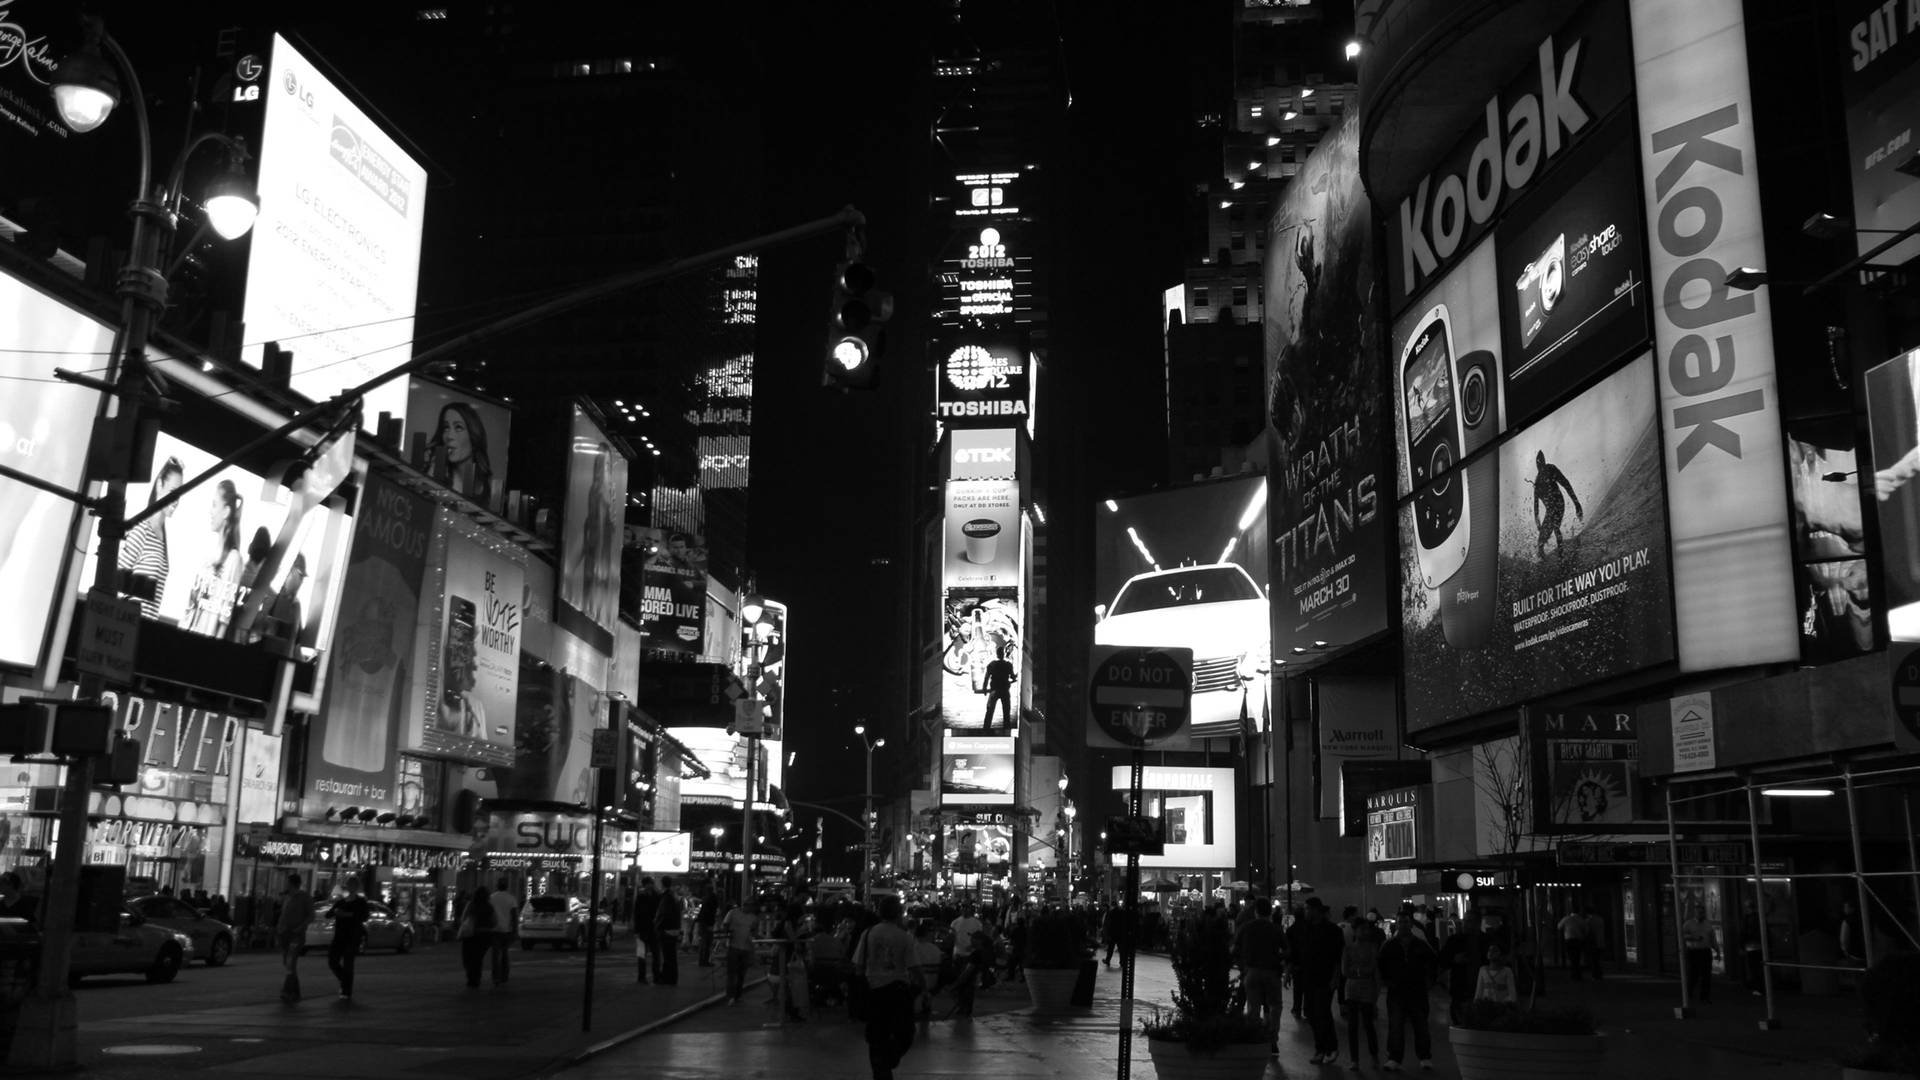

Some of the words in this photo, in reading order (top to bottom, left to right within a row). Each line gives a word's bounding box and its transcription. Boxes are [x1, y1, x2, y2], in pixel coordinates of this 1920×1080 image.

[1850, 0, 1897, 72] SAT
[234, 86, 260, 102] LG
[299, 84, 315, 109] LG
[1400, 34, 1590, 297] Kodak
[296, 181, 311, 206] LG
[313, 196, 388, 266] ELECTRONICS
[968, 244, 1005, 259] 2012
[1571, 223, 1615, 269] easyshare
[1601, 231, 1623, 257] touch
[959, 257, 1015, 269] TOSHIBA
[959, 279, 1014, 291] TOSHIBA
[1651, 102, 1766, 474] Kodak
[940, 400, 1028, 416] TOSHIBA
[968, 448, 1012, 463] TDK
[1284, 413, 1360, 493] WRATH
[357, 507, 427, 561] AMOUS
[1274, 473, 1377, 583] TITANS
[484, 571, 496, 594] BE
[644, 585, 672, 602] MMA
[1512, 594, 1535, 618] BUILT
[1536, 587, 1554, 608] FOR
[1555, 579, 1574, 600] THE
[1575, 568, 1597, 593] WAY
[1597, 558, 1621, 584] YOU
[1622, 547, 1651, 574] PLAY.
[1300, 582, 1334, 616] MARCH
[1513, 610, 1550, 633] WATERPROOF.
[1550, 596, 1590, 620] SHOCKPROOF.
[1590, 580, 1630, 605] DUSTPROOF.
[675, 603, 700, 621] LIVE
[95, 625, 125, 648] MUST
[481, 624, 517, 656] WORTHY
[1108, 664, 1134, 683] DO
[1138, 666, 1175, 684] NOT
[1111, 709, 1168, 730] ENTER
[1543, 712, 1633, 733] MAR
[1329, 729, 1385, 744] Marriott
[315, 778, 362, 799] restaurant
[371, 785, 388, 801] bar
[1367, 790, 1417, 809] MARQUIS
[333, 843, 384, 866] PLANET
